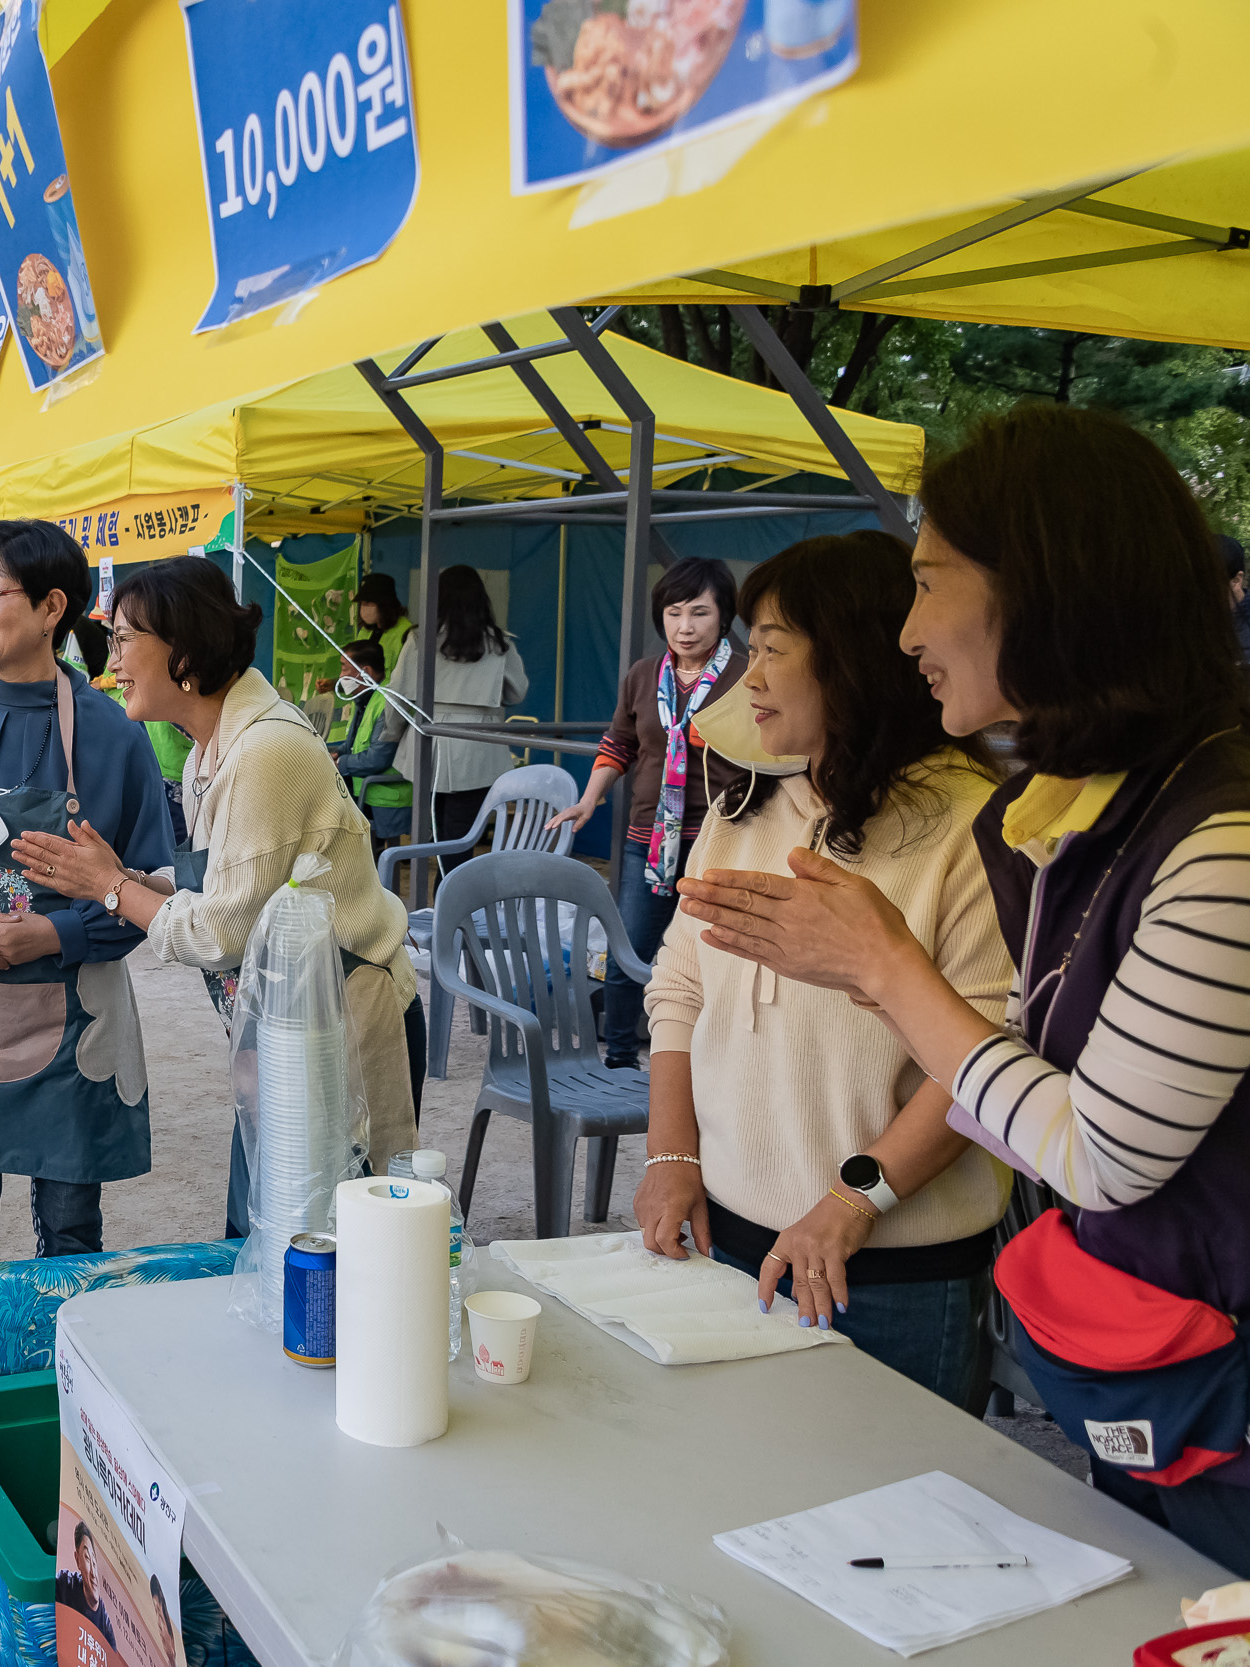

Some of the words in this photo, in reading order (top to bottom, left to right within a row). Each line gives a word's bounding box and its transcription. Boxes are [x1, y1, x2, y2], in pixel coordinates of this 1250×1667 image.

[215, 4, 408, 220] 10,000원
[81, 515, 92, 549] 및
[95, 510, 120, 547] 체험
[134, 503, 200, 541] 자원봉사캠프
[1091, 1433, 1132, 1446] NORTH
[1103, 1425, 1127, 1437] THE
[1104, 1444, 1134, 1454] FACE
[82, 1427, 147, 1556] 광나루아카데미
[160, 1495, 177, 1523] 광진구
[78, 1626, 107, 1667] 기후위기
[78, 1644, 87, 1665] 내
